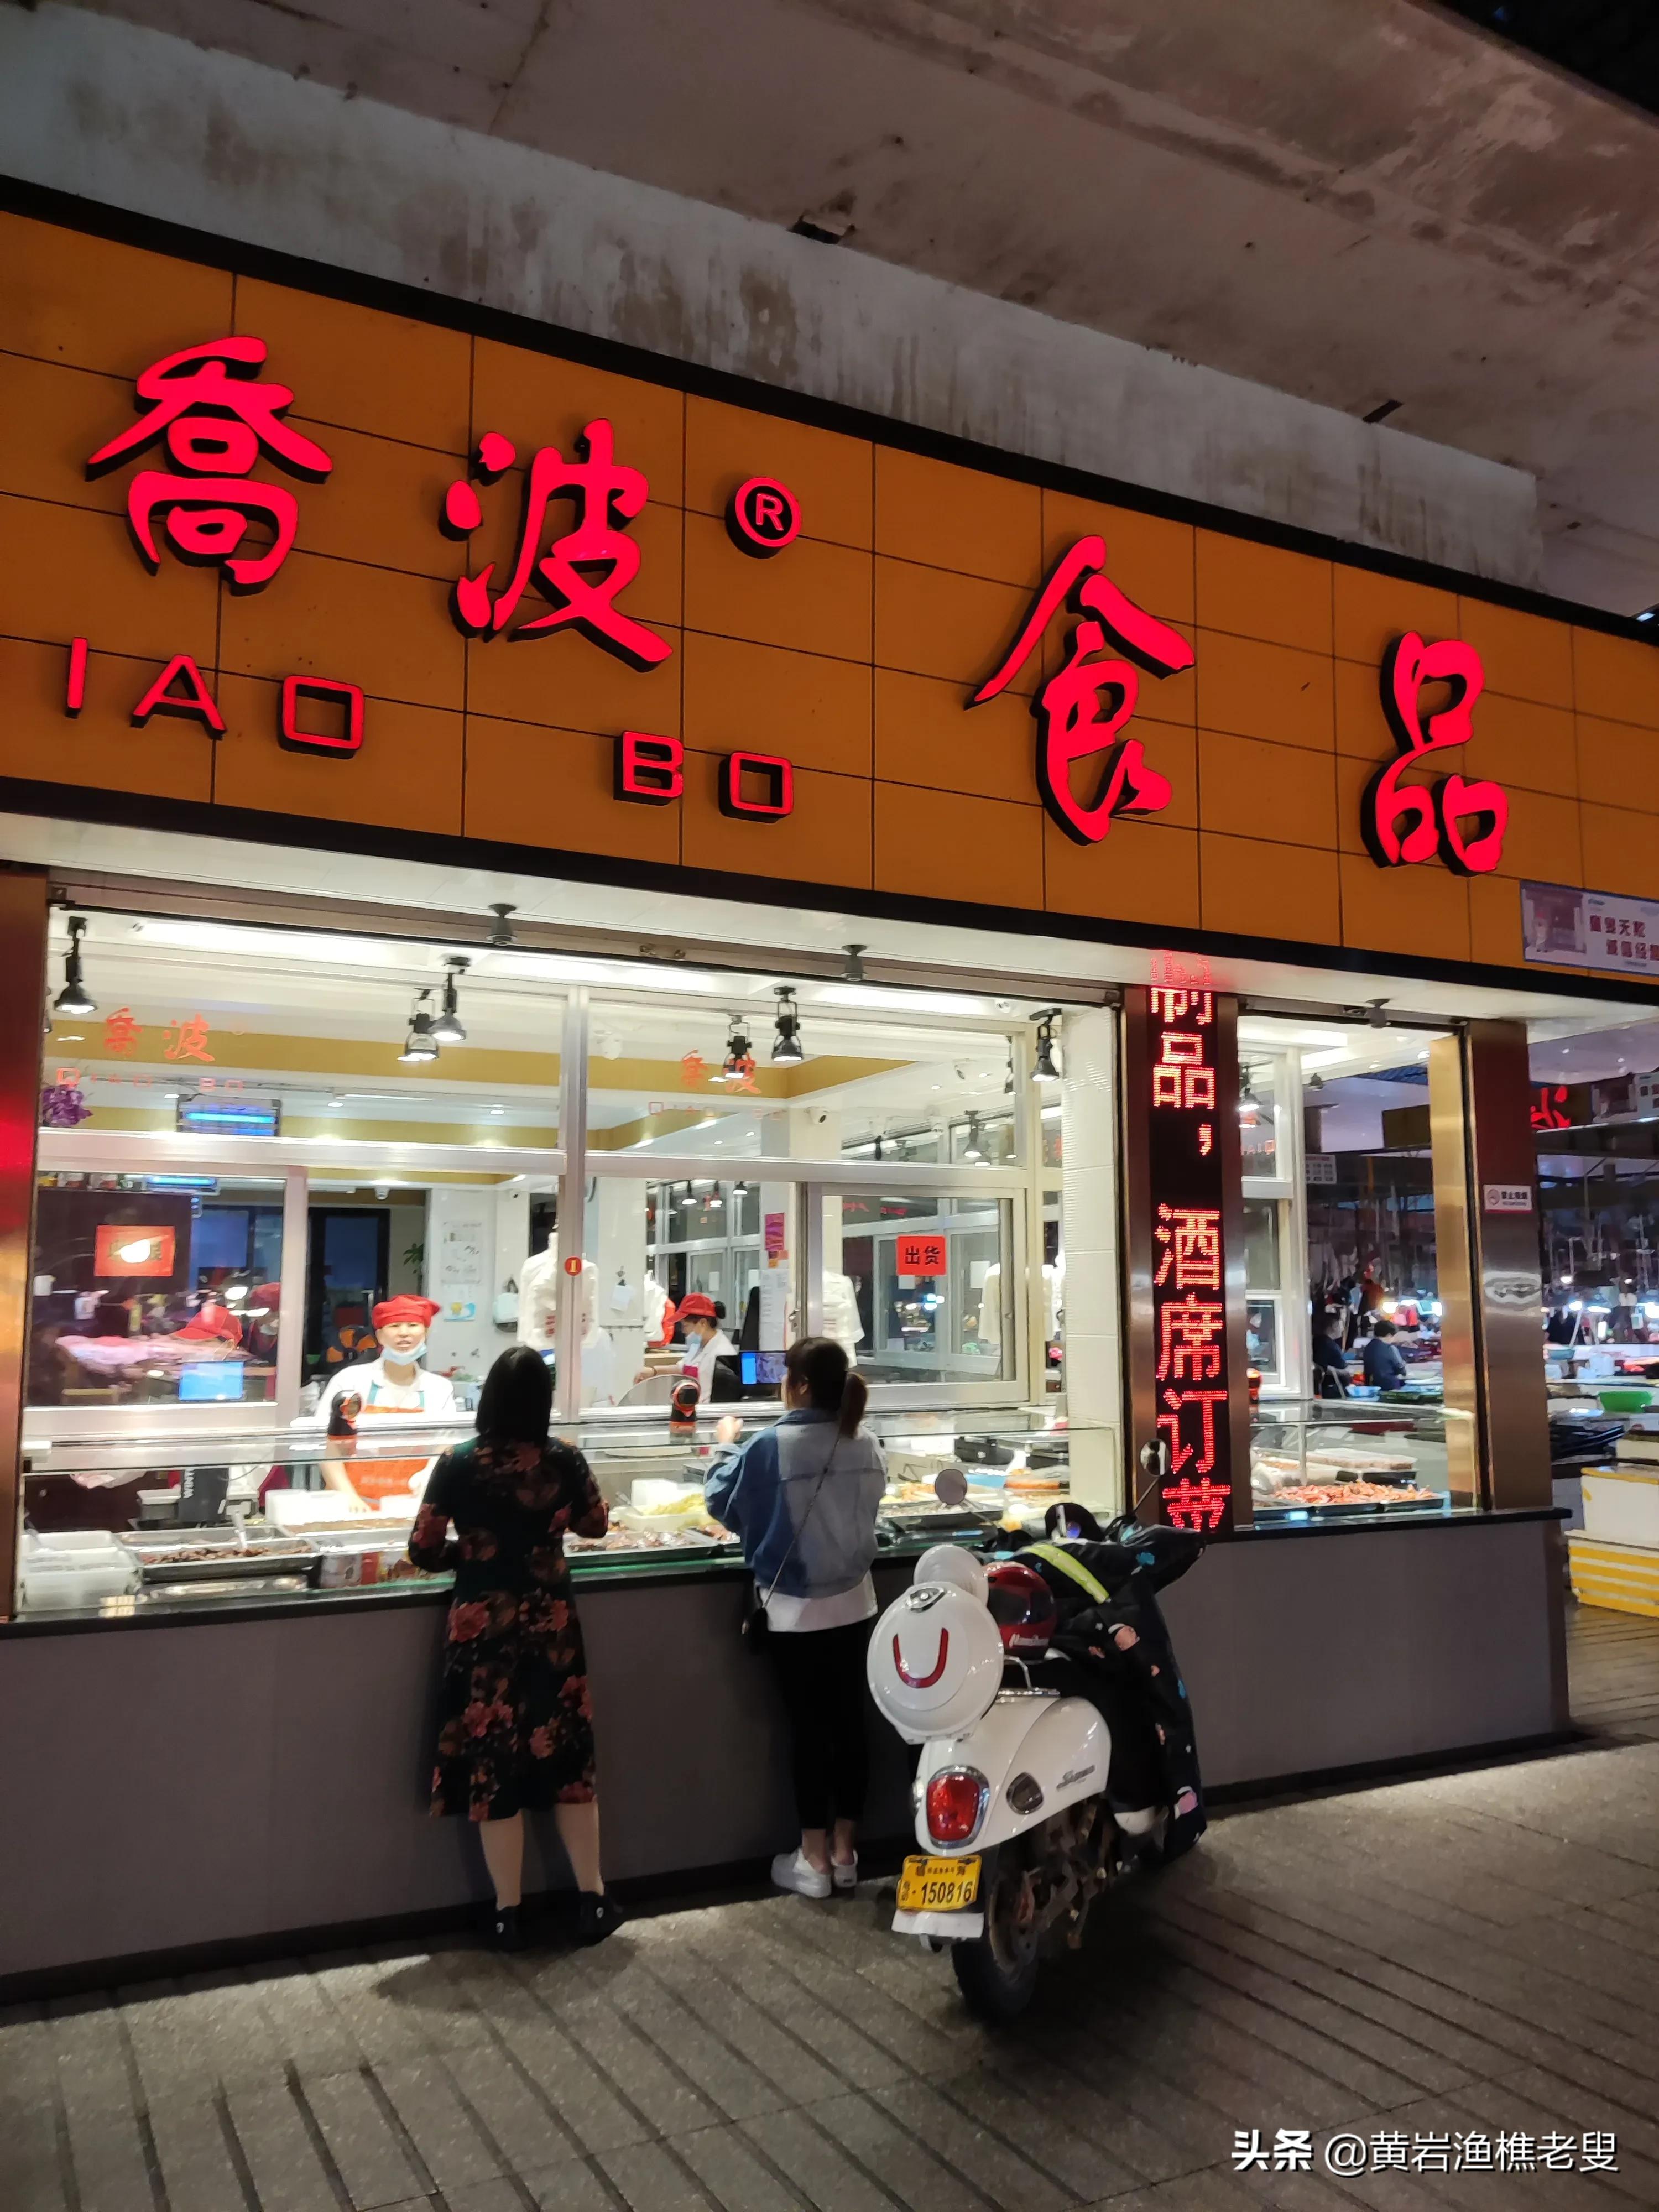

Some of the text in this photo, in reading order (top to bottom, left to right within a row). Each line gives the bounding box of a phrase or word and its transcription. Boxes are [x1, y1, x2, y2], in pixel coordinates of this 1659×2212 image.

[67, 637, 794, 815] IAO BO
[973, 534, 1509, 873] 食品
[904, 1245, 941, 1265] 出货
[920, 1881, 973, 1905] 150816
